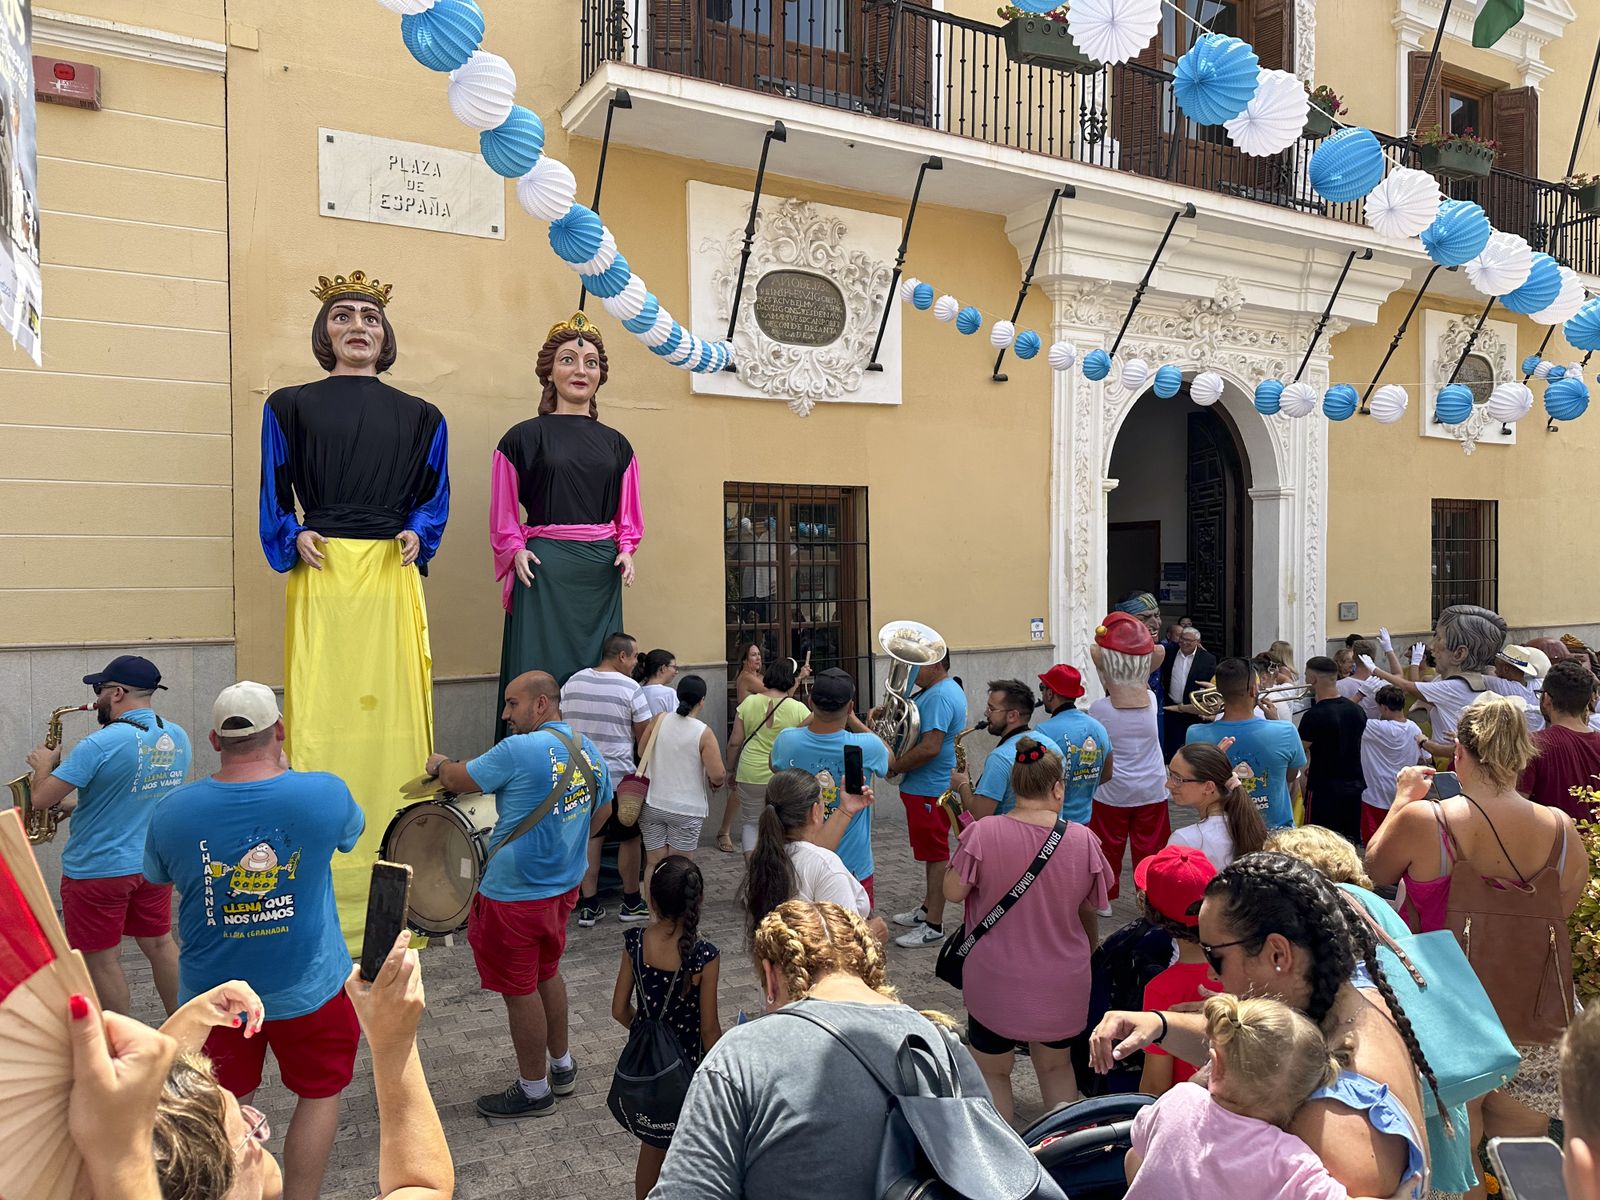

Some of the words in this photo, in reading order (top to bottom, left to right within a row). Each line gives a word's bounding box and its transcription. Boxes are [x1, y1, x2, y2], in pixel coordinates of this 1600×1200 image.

[389, 155, 441, 178] PLAZA
[406, 180, 425, 193] DE
[380, 194, 451, 218] ESPAÑA
[169, 770, 183, 778] QUE
[142, 781, 158, 791] NOS
[564, 799, 578, 813] NOS
[1038, 830, 1062, 860] BIMBA
[199, 840, 217, 926] CHARANGA
[1008, 871, 1035, 898] BIMBA
[223, 902, 262, 913] LLENA
[265, 894, 294, 909] QUE
[223, 914, 250, 925] NOS
[252, 906, 295, 922] VAMOS
[981, 904, 1005, 929] BIMBA
[955, 934, 976, 957] BIMBA
